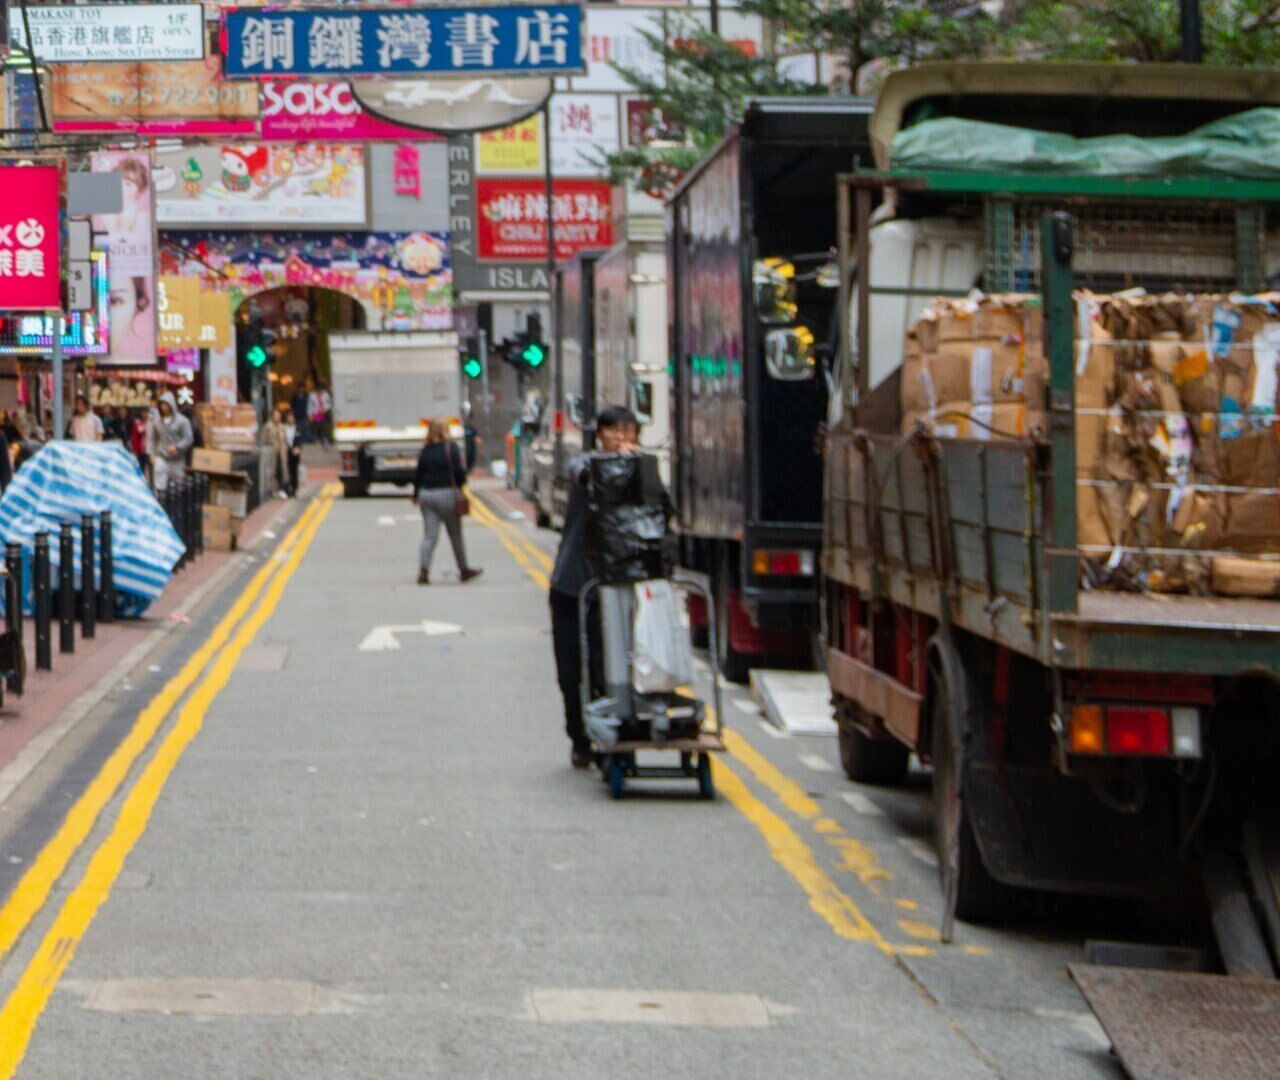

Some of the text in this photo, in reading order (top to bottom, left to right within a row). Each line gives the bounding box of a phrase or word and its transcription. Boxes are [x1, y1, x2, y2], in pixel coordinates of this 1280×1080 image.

[241, 10, 570, 70] 銅鑼灣書店
